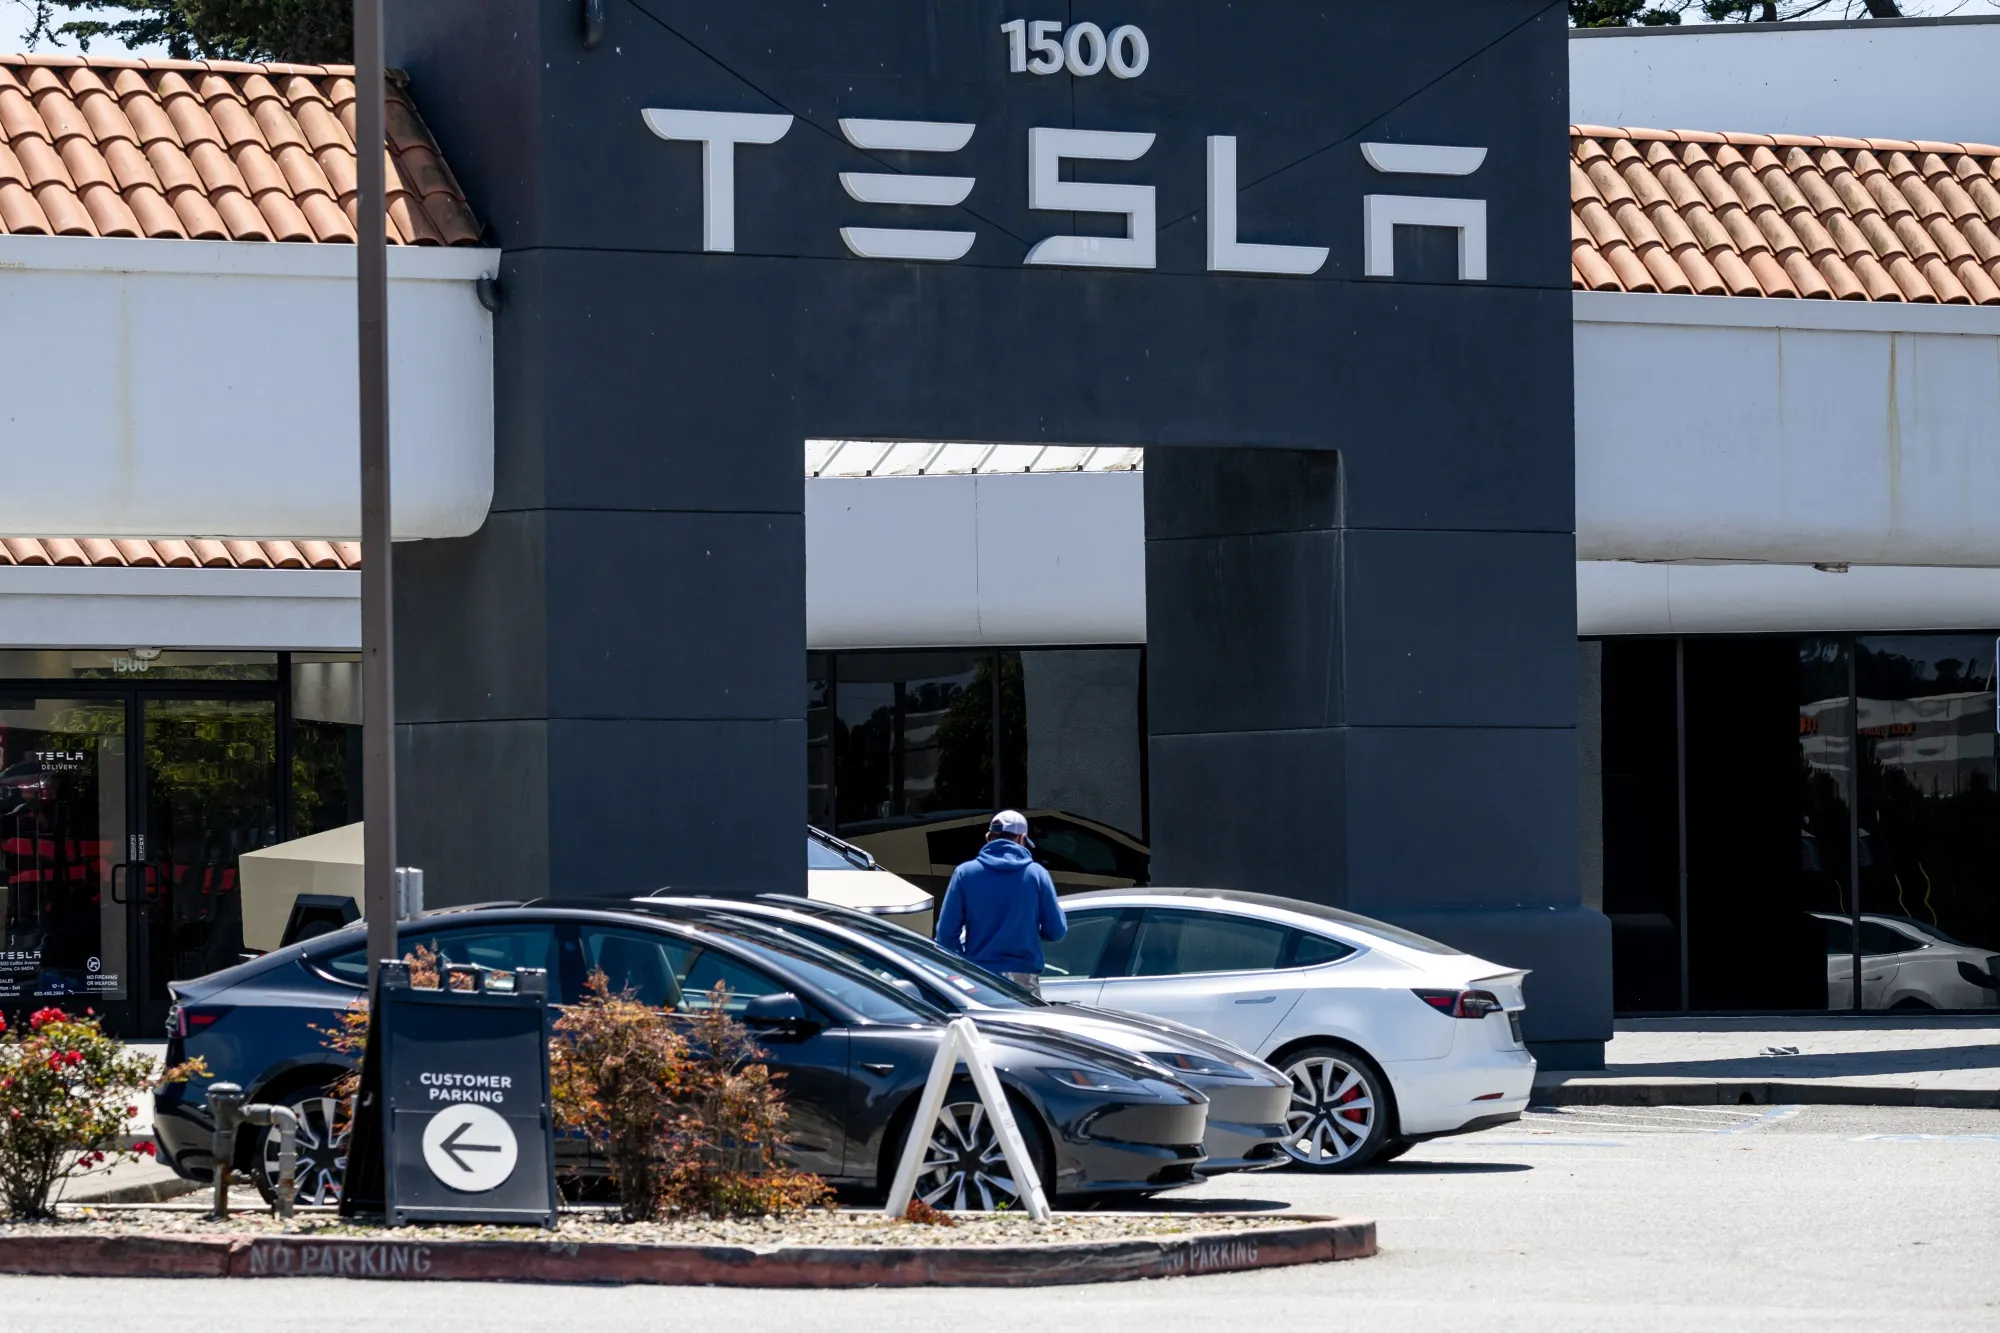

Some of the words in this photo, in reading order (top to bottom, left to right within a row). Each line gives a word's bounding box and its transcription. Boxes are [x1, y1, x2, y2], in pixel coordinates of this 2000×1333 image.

[1001, 19, 1149, 79] 1500
[641, 109, 1489, 281] TESLA
[112, 657, 149, 673] 1500
[41, 763, 78, 771] DELIVERY
[0, 951, 41, 959] TESLA
[420, 1072, 512, 1088] CUSTOMER
[429, 1088, 504, 1103] PARKING
[250, 1244, 291, 1273] NO
[301, 1244, 431, 1274] PARKING
[1190, 1240, 1258, 1270] PARKING
